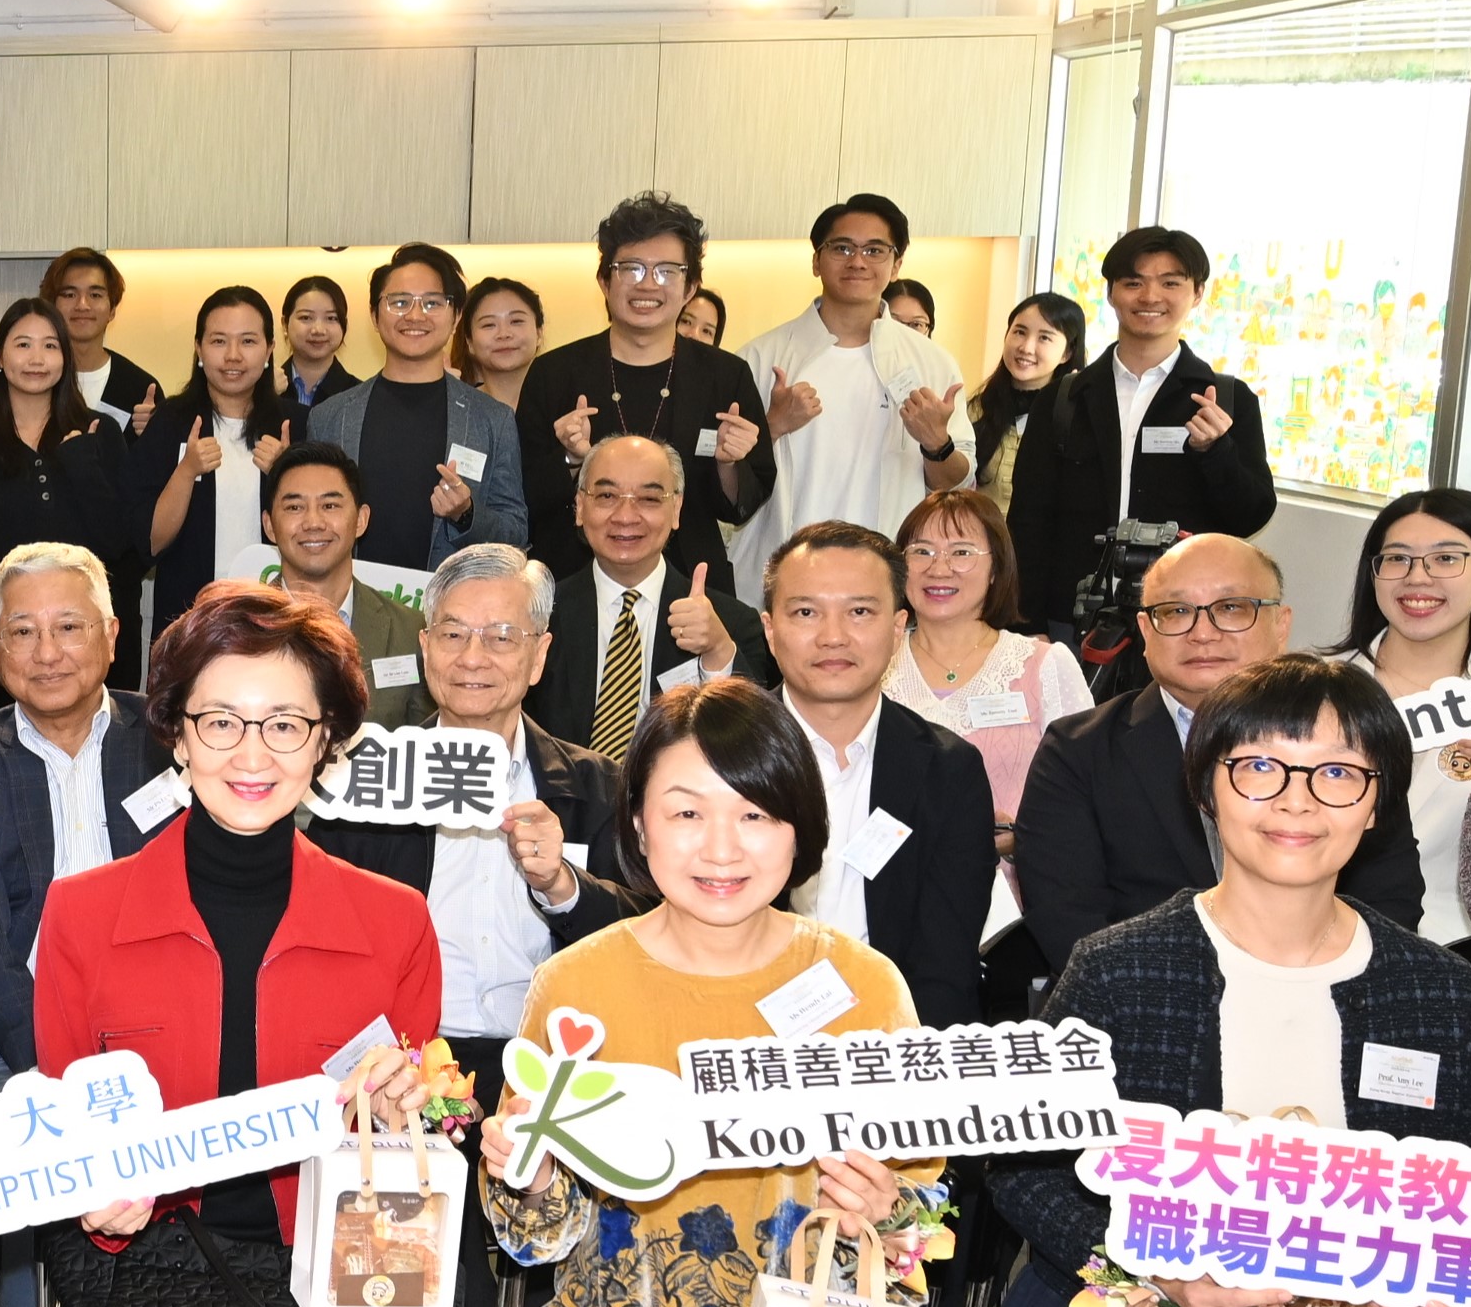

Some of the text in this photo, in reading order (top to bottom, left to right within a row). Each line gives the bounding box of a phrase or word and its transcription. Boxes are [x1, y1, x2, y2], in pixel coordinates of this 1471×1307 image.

[690, 1026, 1108, 1097] 顧積善堂慈善基金
[116, 1098, 323, 1183] UNIVERSITY
[702, 1100, 1120, 1161] Koo Foundation
